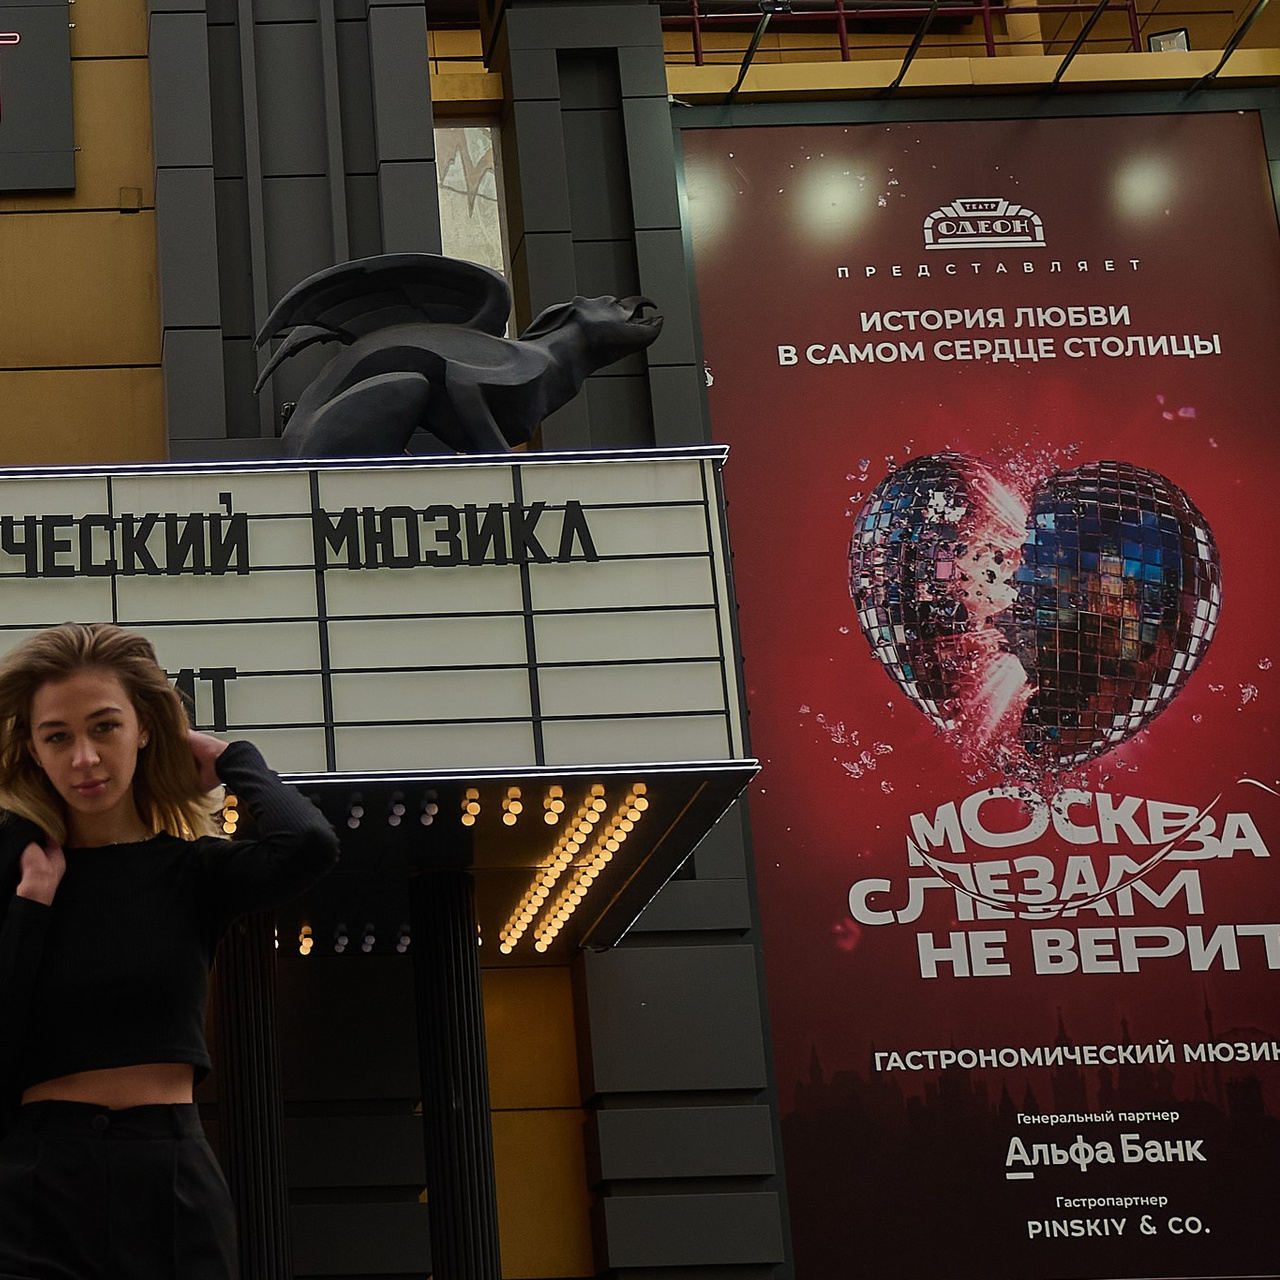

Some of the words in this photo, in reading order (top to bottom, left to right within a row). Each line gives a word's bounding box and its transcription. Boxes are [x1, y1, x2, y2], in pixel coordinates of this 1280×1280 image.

[965, 203, 997, 211] ТЕАТР
[937, 219, 1030, 236] ОДЕОН
[836, 258, 1143, 279] ПРЕДСТАВЛЯЕТ
[859, 307, 1006, 333] ИСТОРИЯ
[1013, 304, 1132, 329] ЛЮБВИ
[776, 343, 798, 366] В
[805, 341, 926, 366] САМОМ
[932, 337, 1057, 364] СЕРДЦЕ
[1062, 333, 1222, 360] СТОЛИЦЫ
[314, 499, 600, 571] МЮЗИКЛ
[906, 786, 1272, 868] МОСКВА
[847, 854, 1205, 926] СЛЕЗАМ
[916, 930, 1012, 979] НЕ
[1030, 923, 1280, 976] ВЕРИТ
[873, 1038, 1177, 1073] ГАСТРОНОМИЧЕСКИЙ
[1016, 1110, 1115, 1126] Генеральный
[1118, 1110, 1180, 1123] партнер
[1005, 1134, 1116, 1173] Альфа
[1120, 1133, 1208, 1164] Банк
[1055, 1195, 1168, 1210] Гастропартнер
[1027, 1217, 1127, 1240] PINSKIY
[1139, 1214, 1158, 1236] &
[1167, 1216, 1211, 1235] CO.
